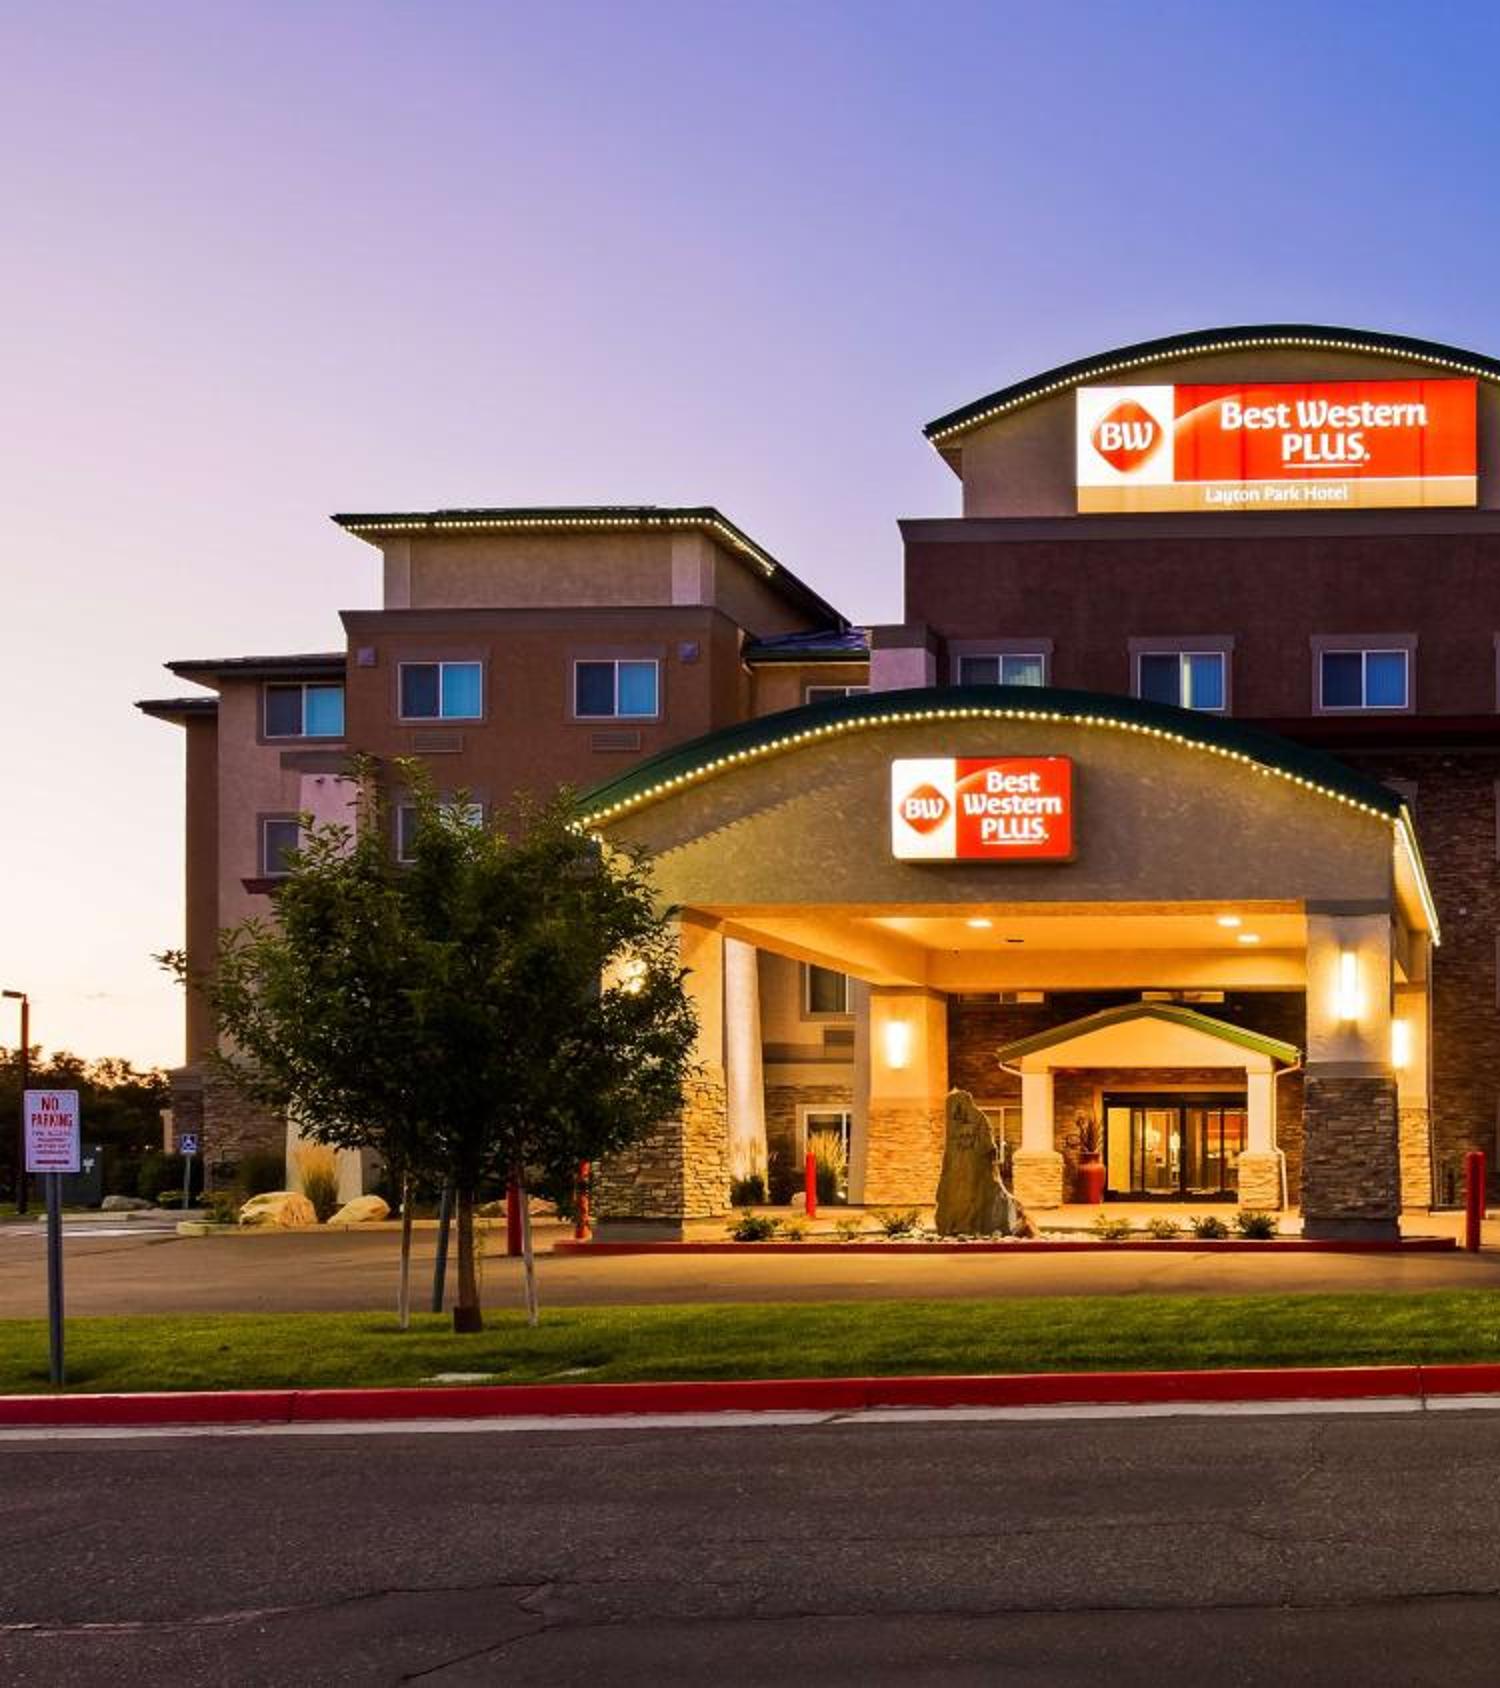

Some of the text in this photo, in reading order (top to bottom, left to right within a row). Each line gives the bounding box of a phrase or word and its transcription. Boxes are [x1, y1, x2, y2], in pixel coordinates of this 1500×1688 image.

[1220, 400, 1427, 430] Best Western
[1100, 421, 1153, 452] BW
[1205, 484, 1348, 507] Layton Park Hotel
[987, 771, 1040, 793] Best
[905, 798, 944, 819] BW
[963, 793, 1063, 816] Western
[41, 1096, 59, 1111] NO
[31, 1113, 73, 1128] PARKING
